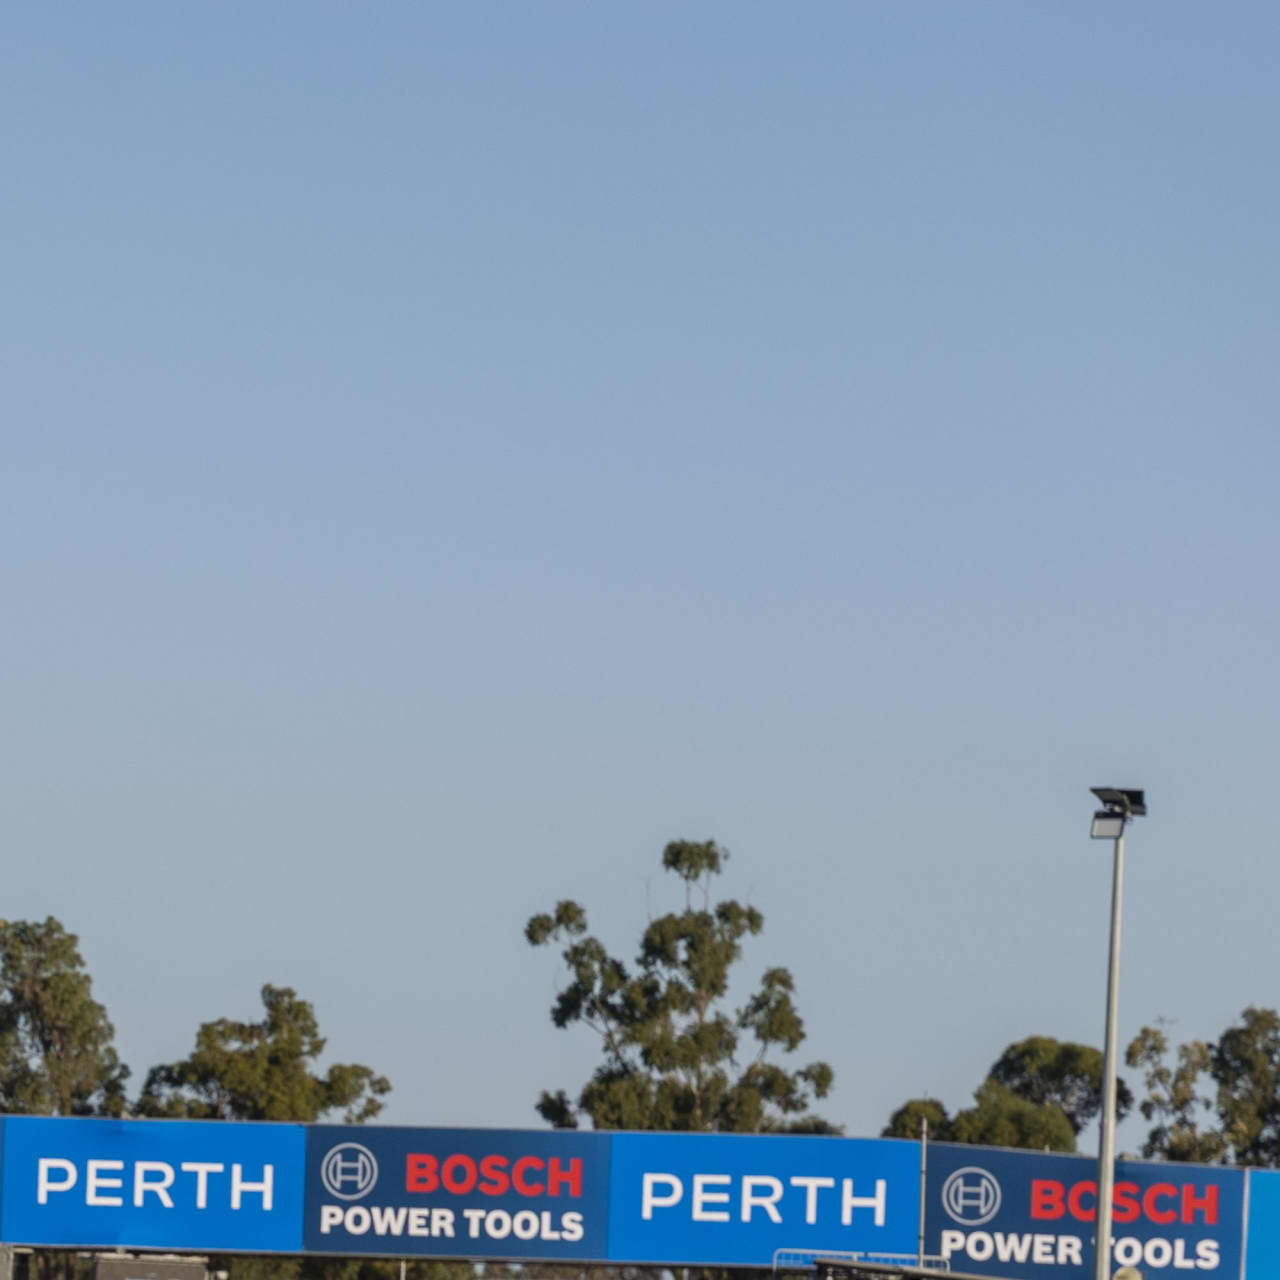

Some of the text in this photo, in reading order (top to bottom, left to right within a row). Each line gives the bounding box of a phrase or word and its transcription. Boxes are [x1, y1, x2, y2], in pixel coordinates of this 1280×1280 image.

[37, 1157, 275, 1211] PERTH
[406, 1152, 583, 1198] BOSCH
[642, 1171, 886, 1227] PERTH
[1030, 1178, 1219, 1225] BOSCH
[320, 1204, 584, 1242] POWER TOOLS
[940, 1228, 1220, 1270] POWER OOLS
